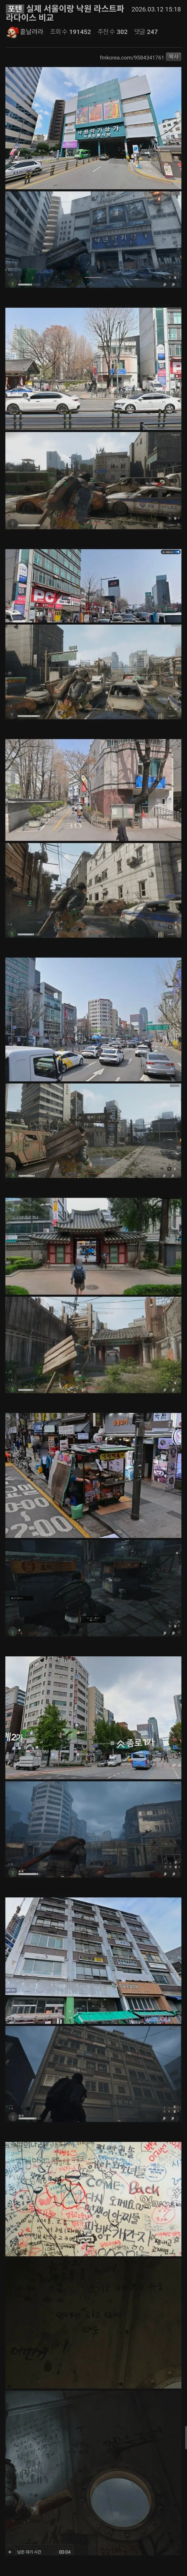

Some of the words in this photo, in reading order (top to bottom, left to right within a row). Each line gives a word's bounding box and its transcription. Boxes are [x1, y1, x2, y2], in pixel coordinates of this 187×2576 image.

[78, 125, 119, 135] 낙원악기상가
[34, 589, 54, 603] PC
[86, 2177, 120, 2191] COME
[129, 2180, 159, 2196] Back
[85, 2192, 103, 2204] 다시
[85, 2310, 102, 2318] 하고
[83, 2326, 99, 2335] 나도
